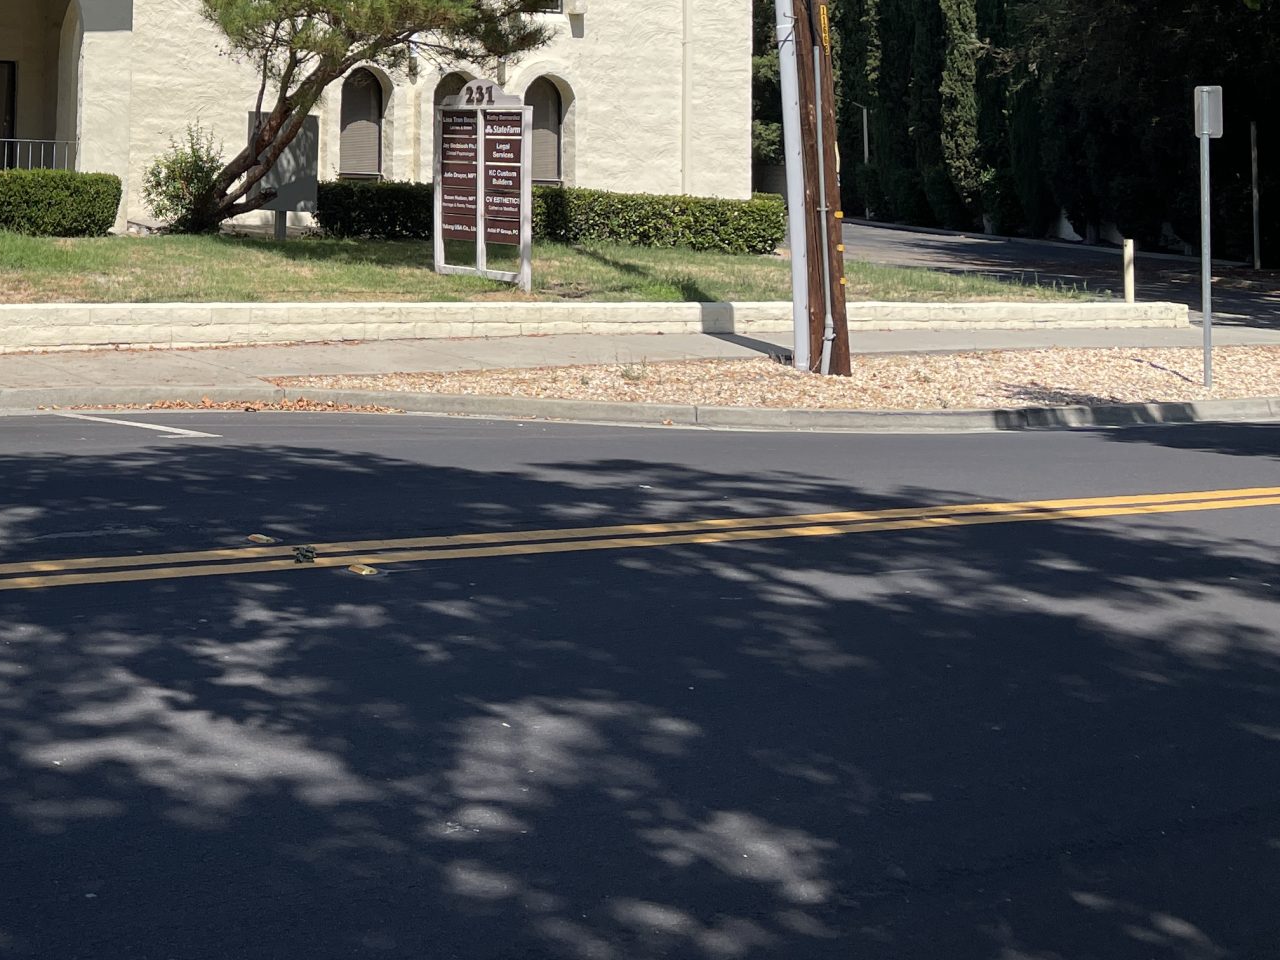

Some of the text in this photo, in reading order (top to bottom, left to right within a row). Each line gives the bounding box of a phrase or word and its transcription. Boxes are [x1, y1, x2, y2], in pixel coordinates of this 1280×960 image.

[465, 85, 495, 105] 231
[496, 142, 511, 150] Legal
[492, 150, 514, 158] Services
[497, 169, 517, 177] Custom
[492, 177, 513, 186] Builders
